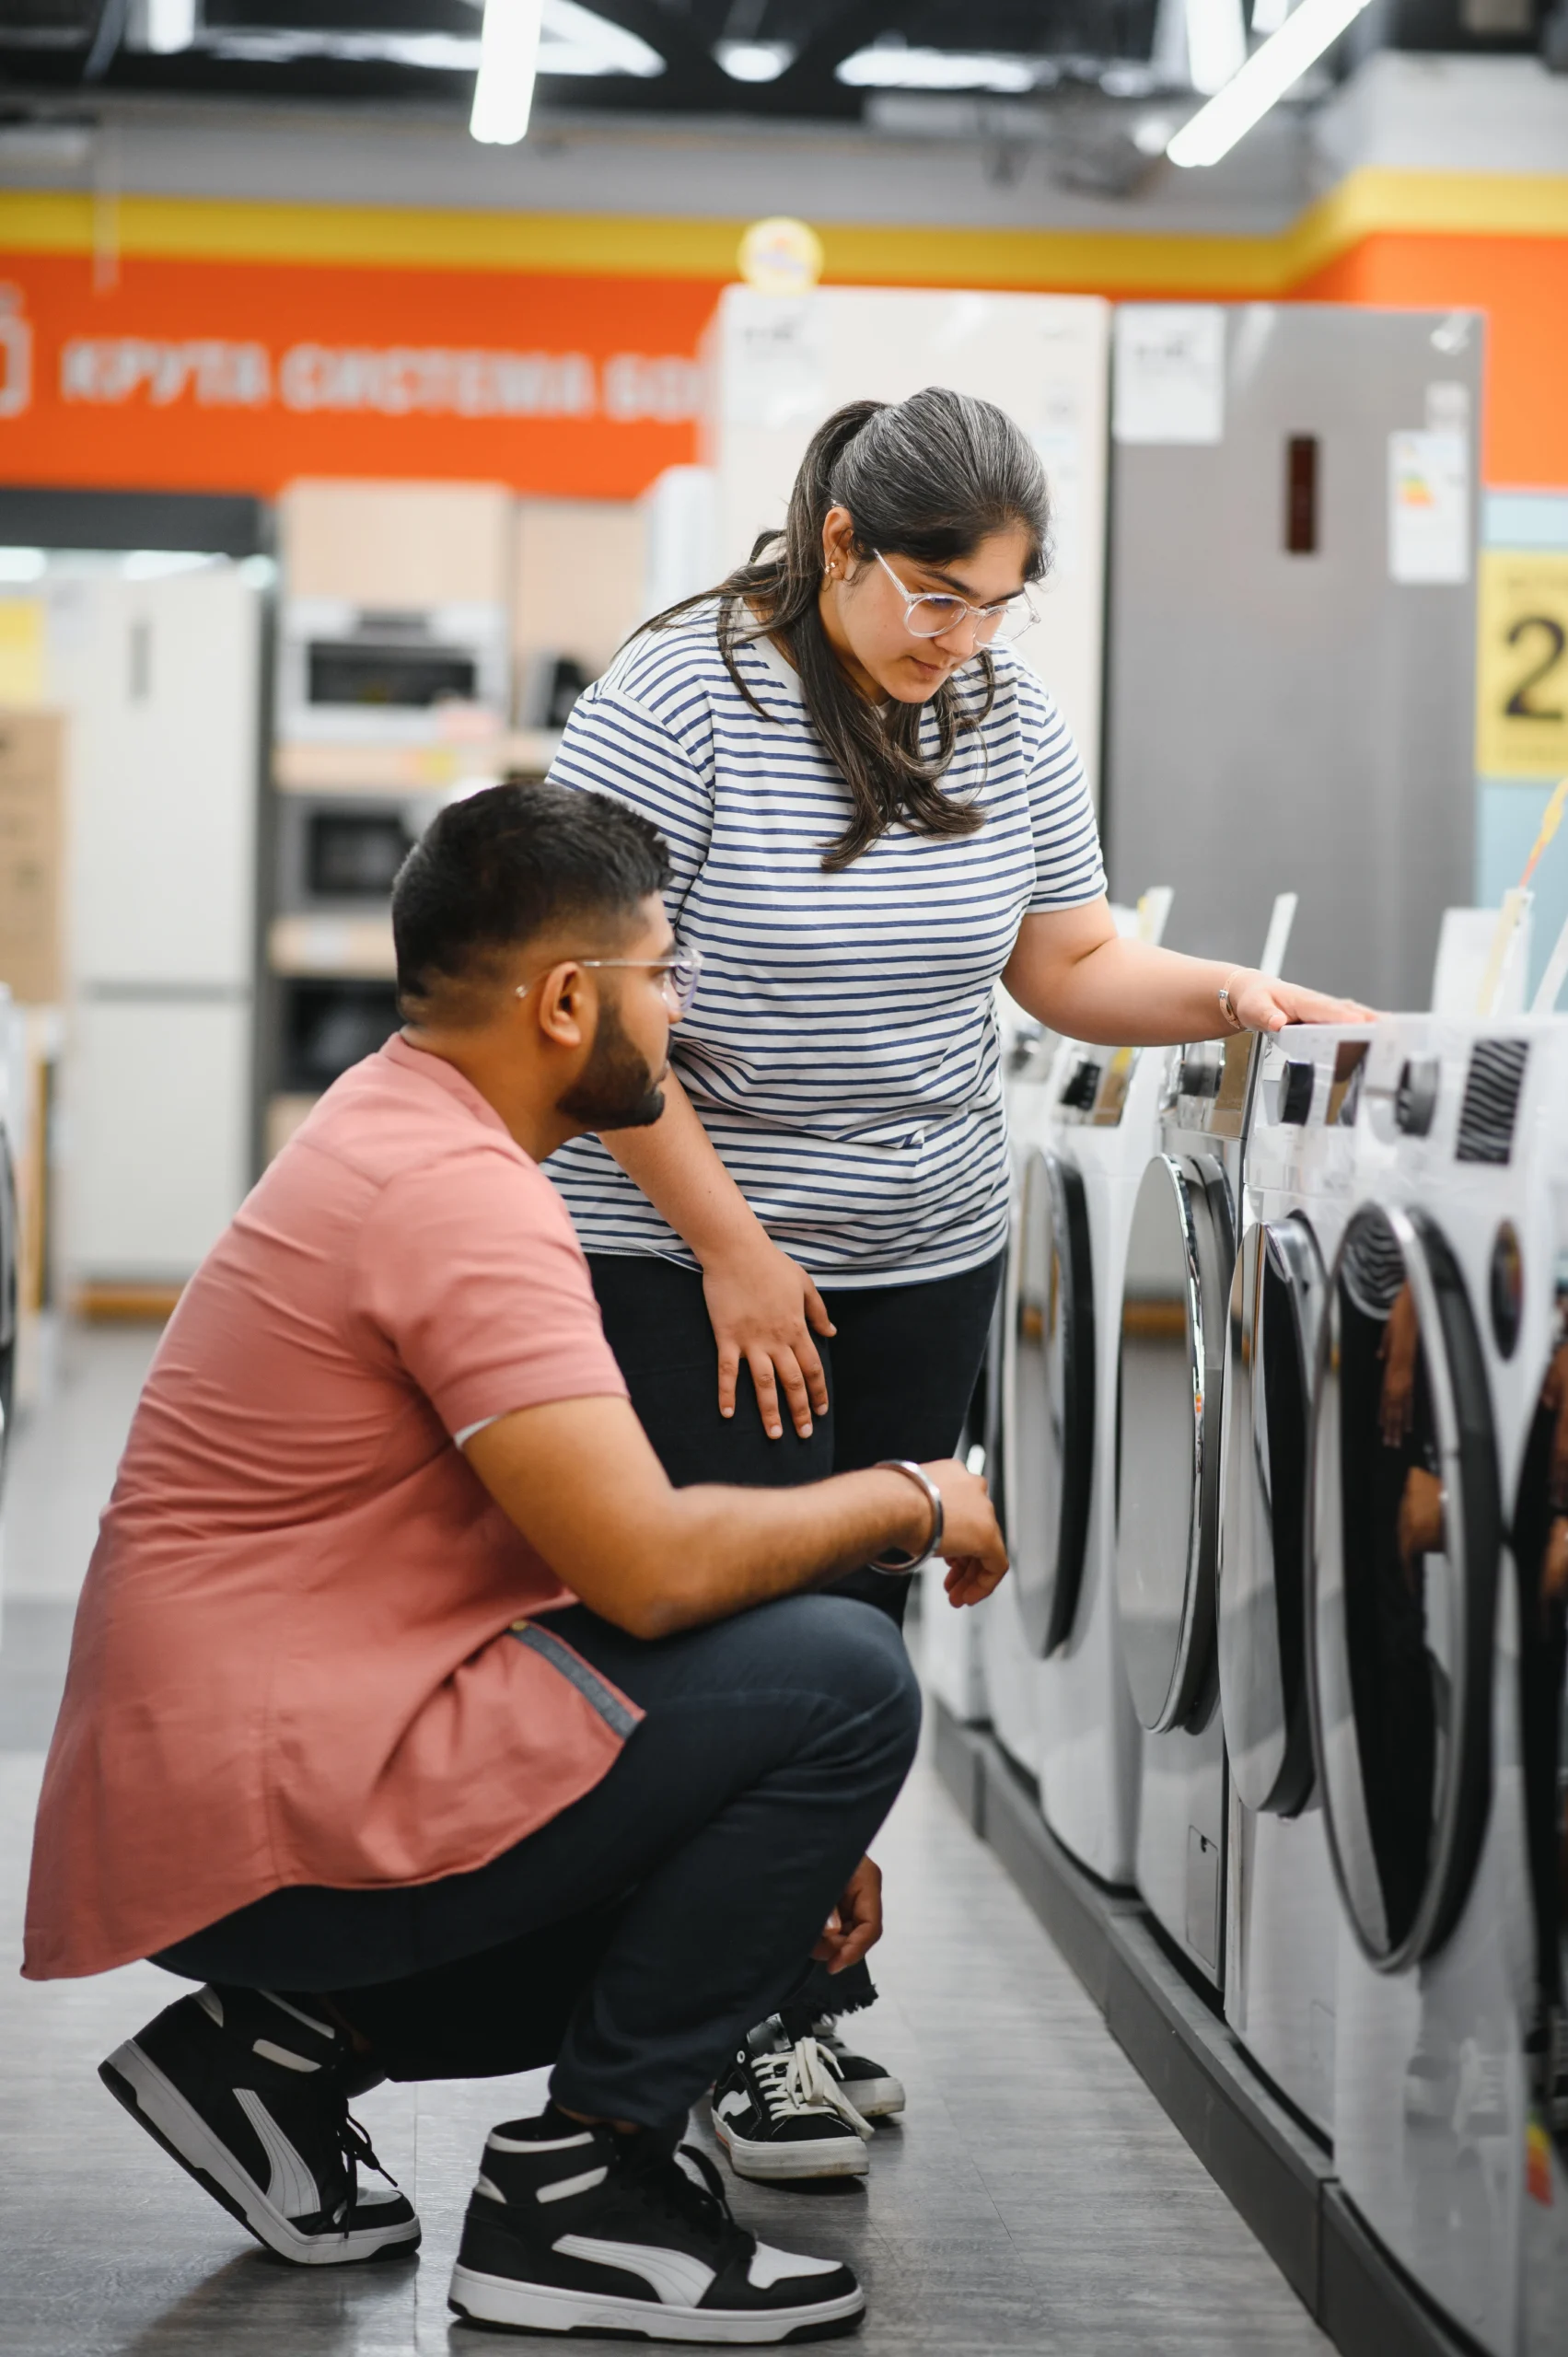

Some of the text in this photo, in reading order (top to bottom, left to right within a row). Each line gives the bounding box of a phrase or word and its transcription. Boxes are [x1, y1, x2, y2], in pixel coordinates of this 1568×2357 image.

[61, 337, 271, 407] КРУТА
[280, 343, 595, 420] СИСТЕМА
[1504, 614, 1565, 720] 2
